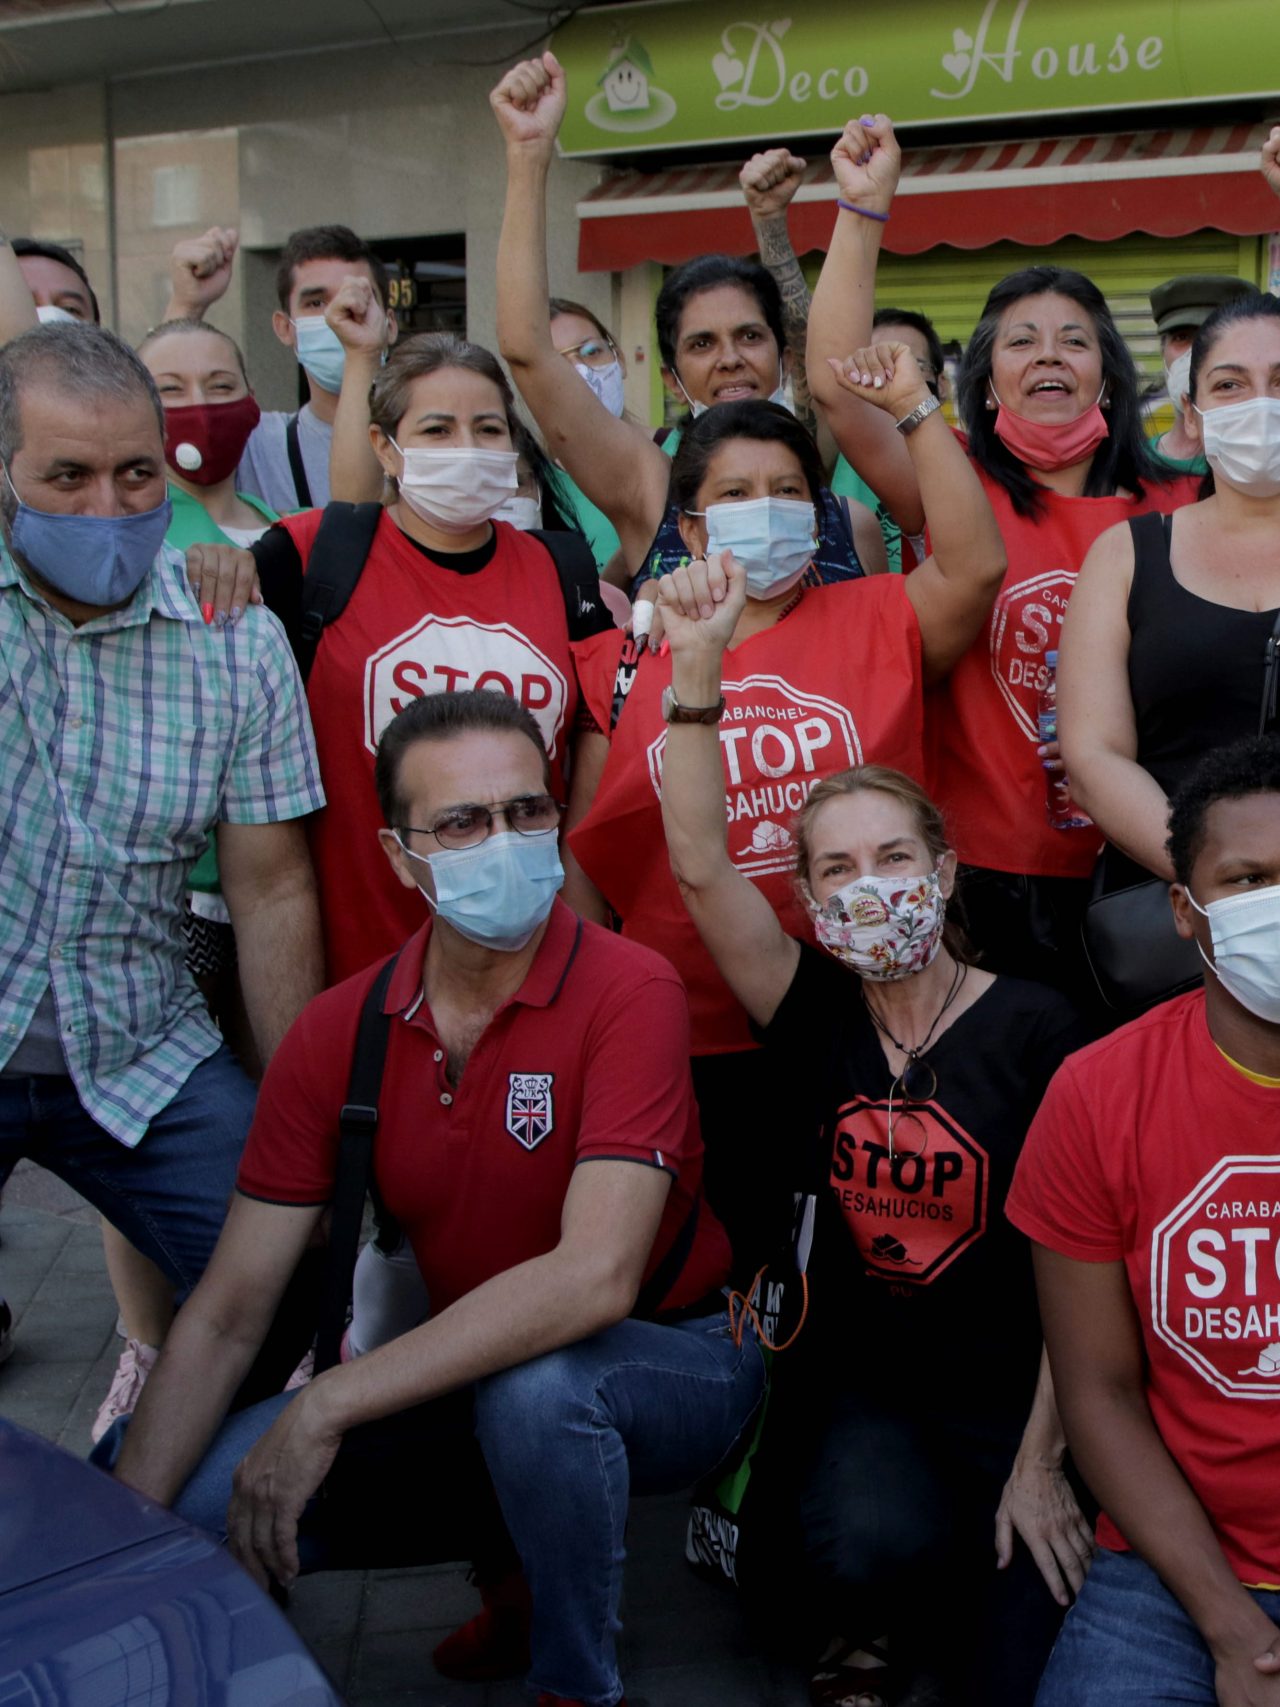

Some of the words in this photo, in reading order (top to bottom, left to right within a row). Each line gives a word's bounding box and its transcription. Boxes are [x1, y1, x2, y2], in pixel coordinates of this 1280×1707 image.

[715, 21, 869, 111] Deco
[930, 0, 1163, 99] House
[388, 278, 412, 307] 95
[1008, 658, 1050, 692] DES
[719, 705, 808, 723] ABANCHEL
[719, 717, 832, 785] TOP
[832, 1131, 963, 1197] STOP
